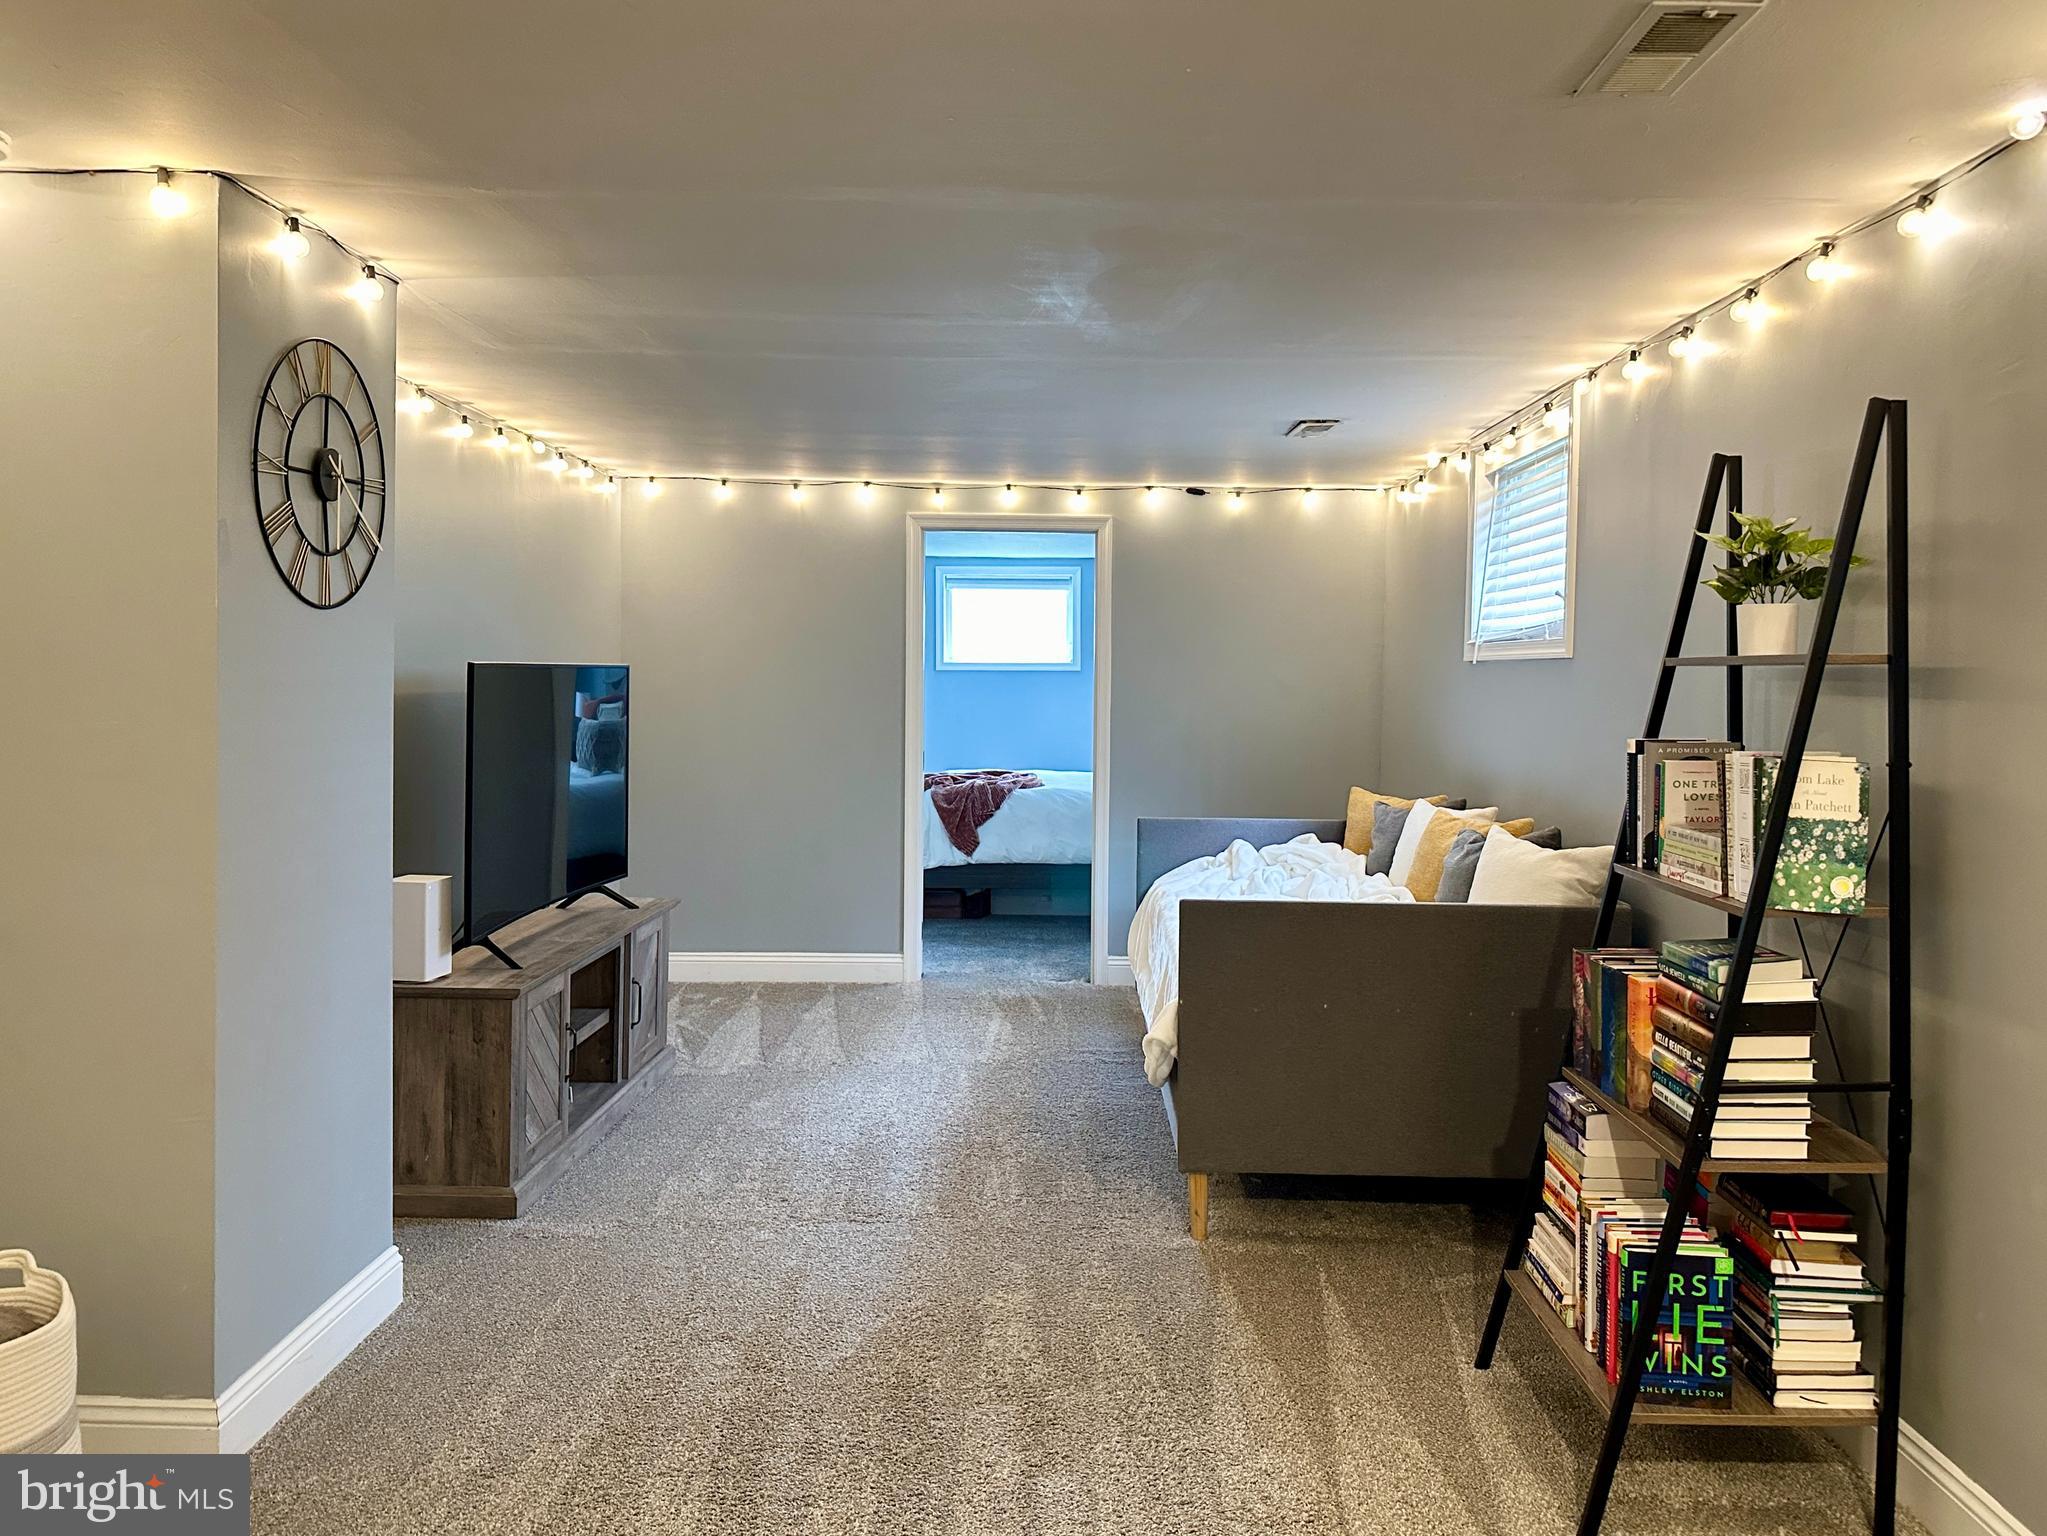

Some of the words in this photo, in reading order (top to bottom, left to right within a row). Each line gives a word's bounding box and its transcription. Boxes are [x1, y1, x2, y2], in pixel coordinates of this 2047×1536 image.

[1672, 780, 1698, 788] ONE
[1702, 780, 1718, 788] TR
[1797, 776, 1813, 784] om
[1817, 773, 1845, 785] Lake
[1683, 793, 1721, 801] LOVES
[1805, 799, 1852, 813] Patchett
[1632, 1270, 1729, 1298] FRST
[1640, 1385, 1675, 1394] SHLEY
[1681, 1388, 1724, 1398] ELSTON
